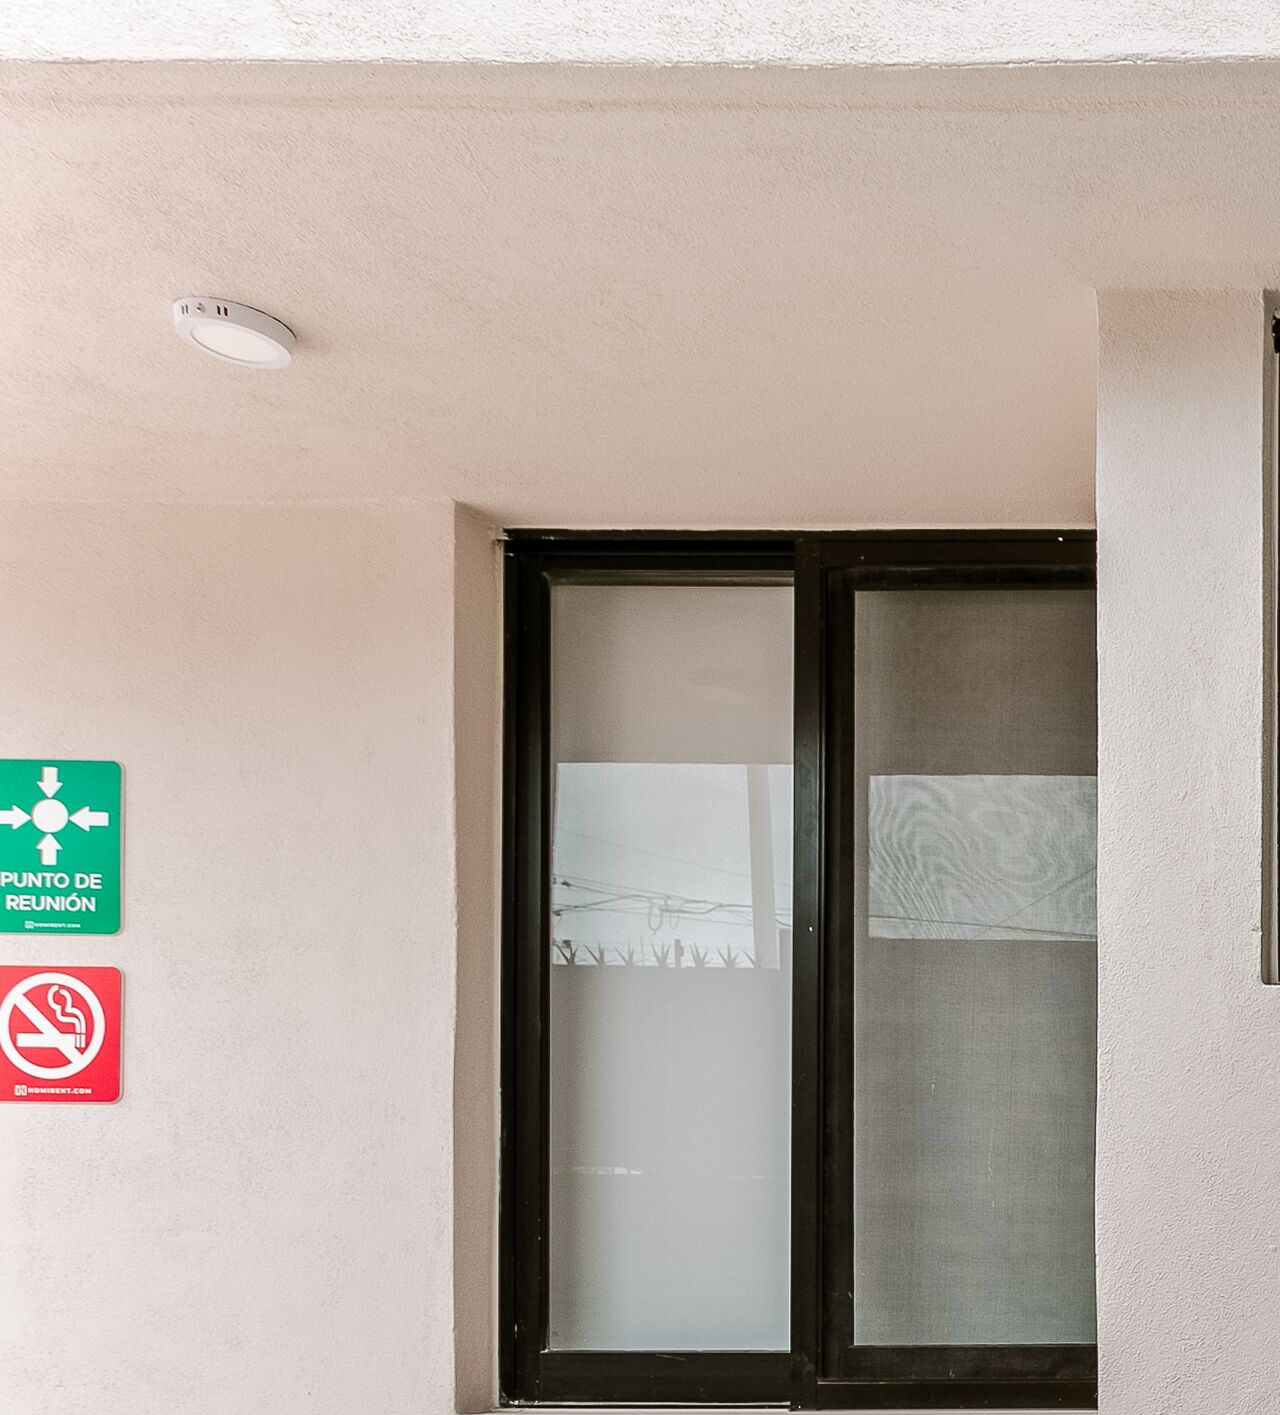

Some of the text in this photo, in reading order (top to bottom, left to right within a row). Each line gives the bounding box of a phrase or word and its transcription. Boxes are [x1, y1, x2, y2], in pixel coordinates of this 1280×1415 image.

[0, 871, 103, 889] PUNTO DE
[5, 893, 96, 912] REUNIÓN
